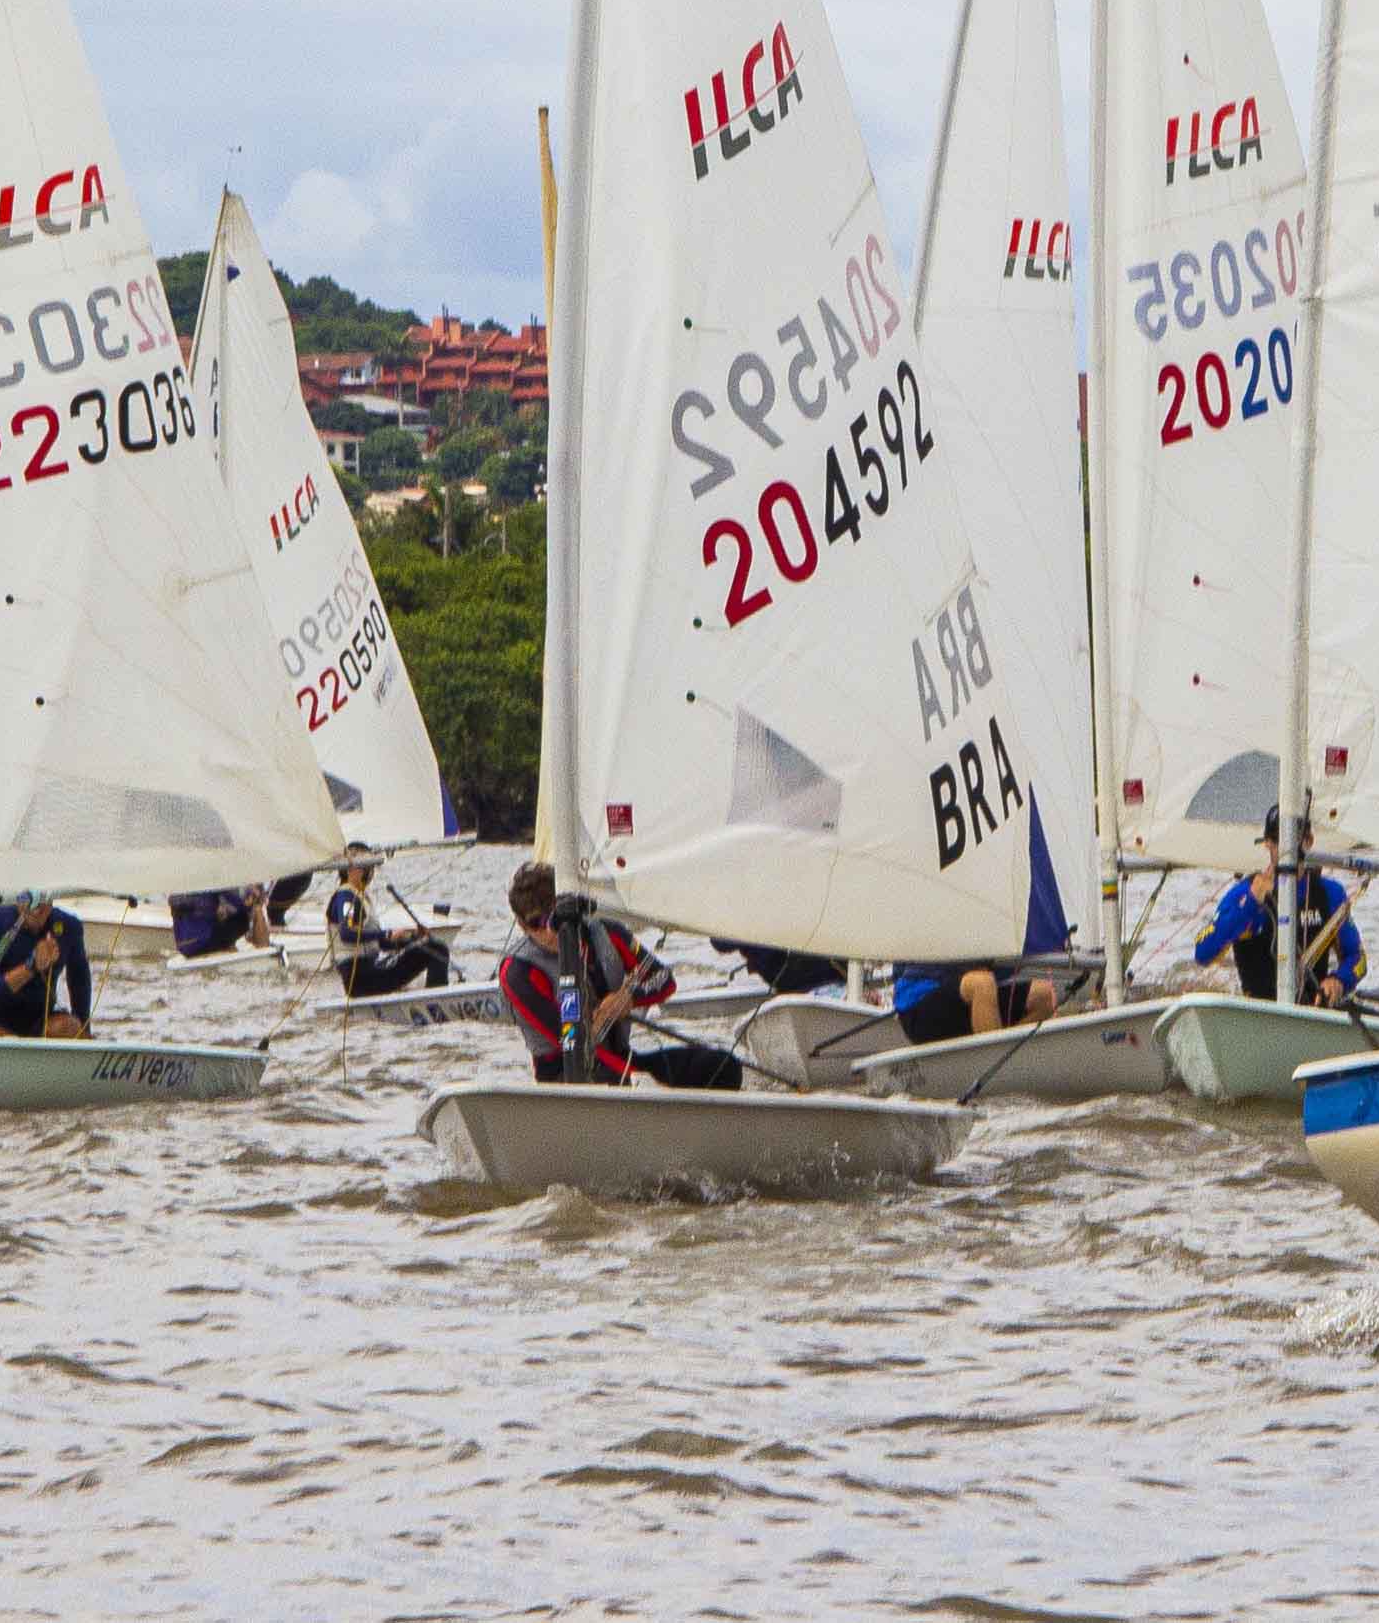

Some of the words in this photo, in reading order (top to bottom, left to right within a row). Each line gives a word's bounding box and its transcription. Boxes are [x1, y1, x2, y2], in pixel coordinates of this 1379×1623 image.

[685, 20, 803, 182] ILCA
[1166, 95, 1263, 187] ILCA
[1004, 218, 1073, 283] ILCA
[270, 473, 319, 554] ILCA
[702, 359, 933, 628] 204592
[296, 599, 387, 732] 220590
[929, 714, 1024, 871] BRA
